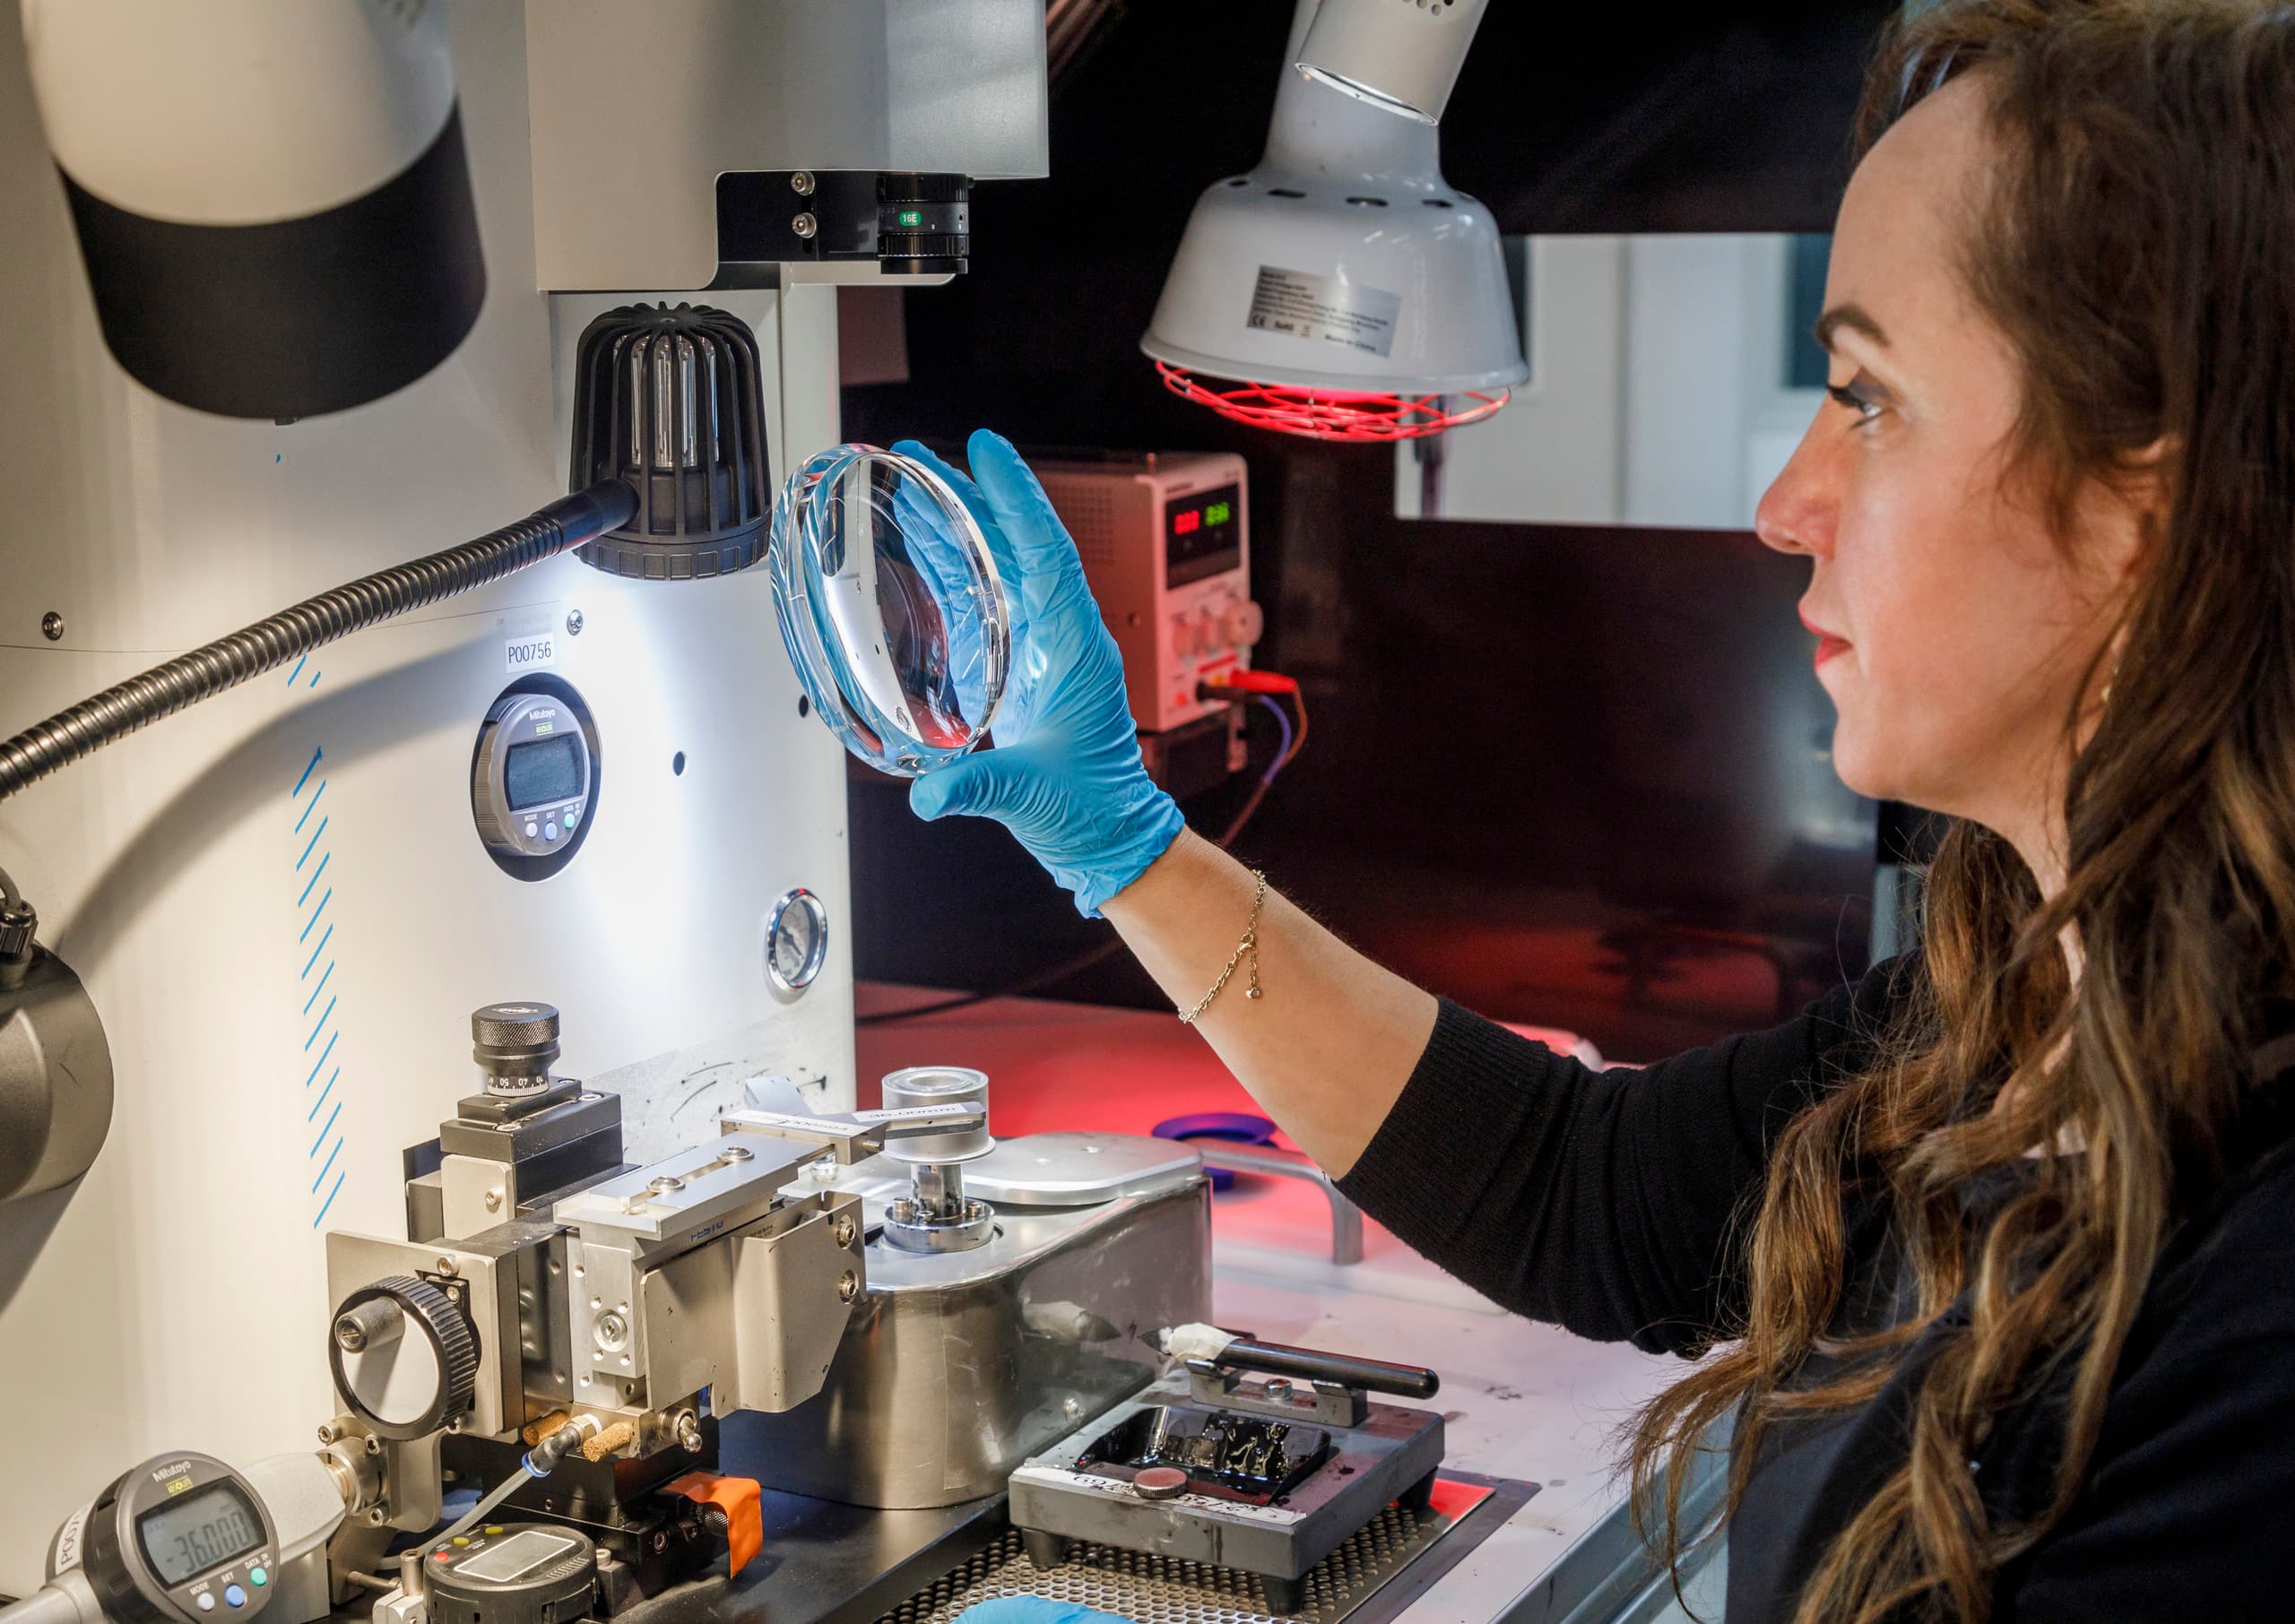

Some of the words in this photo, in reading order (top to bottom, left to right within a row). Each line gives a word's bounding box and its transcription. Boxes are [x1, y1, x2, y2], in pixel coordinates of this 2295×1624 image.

[902, 214, 917, 223] 16E
[508, 642, 551, 663] P00756
[499, 1078, 509, 1086] 50
[152, 1461, 191, 1482] Mitutoyo
[189, 1581, 210, 1596] MODE
[221, 1571, 235, 1584] SET
[244, 1557, 261, 1569] DATA
